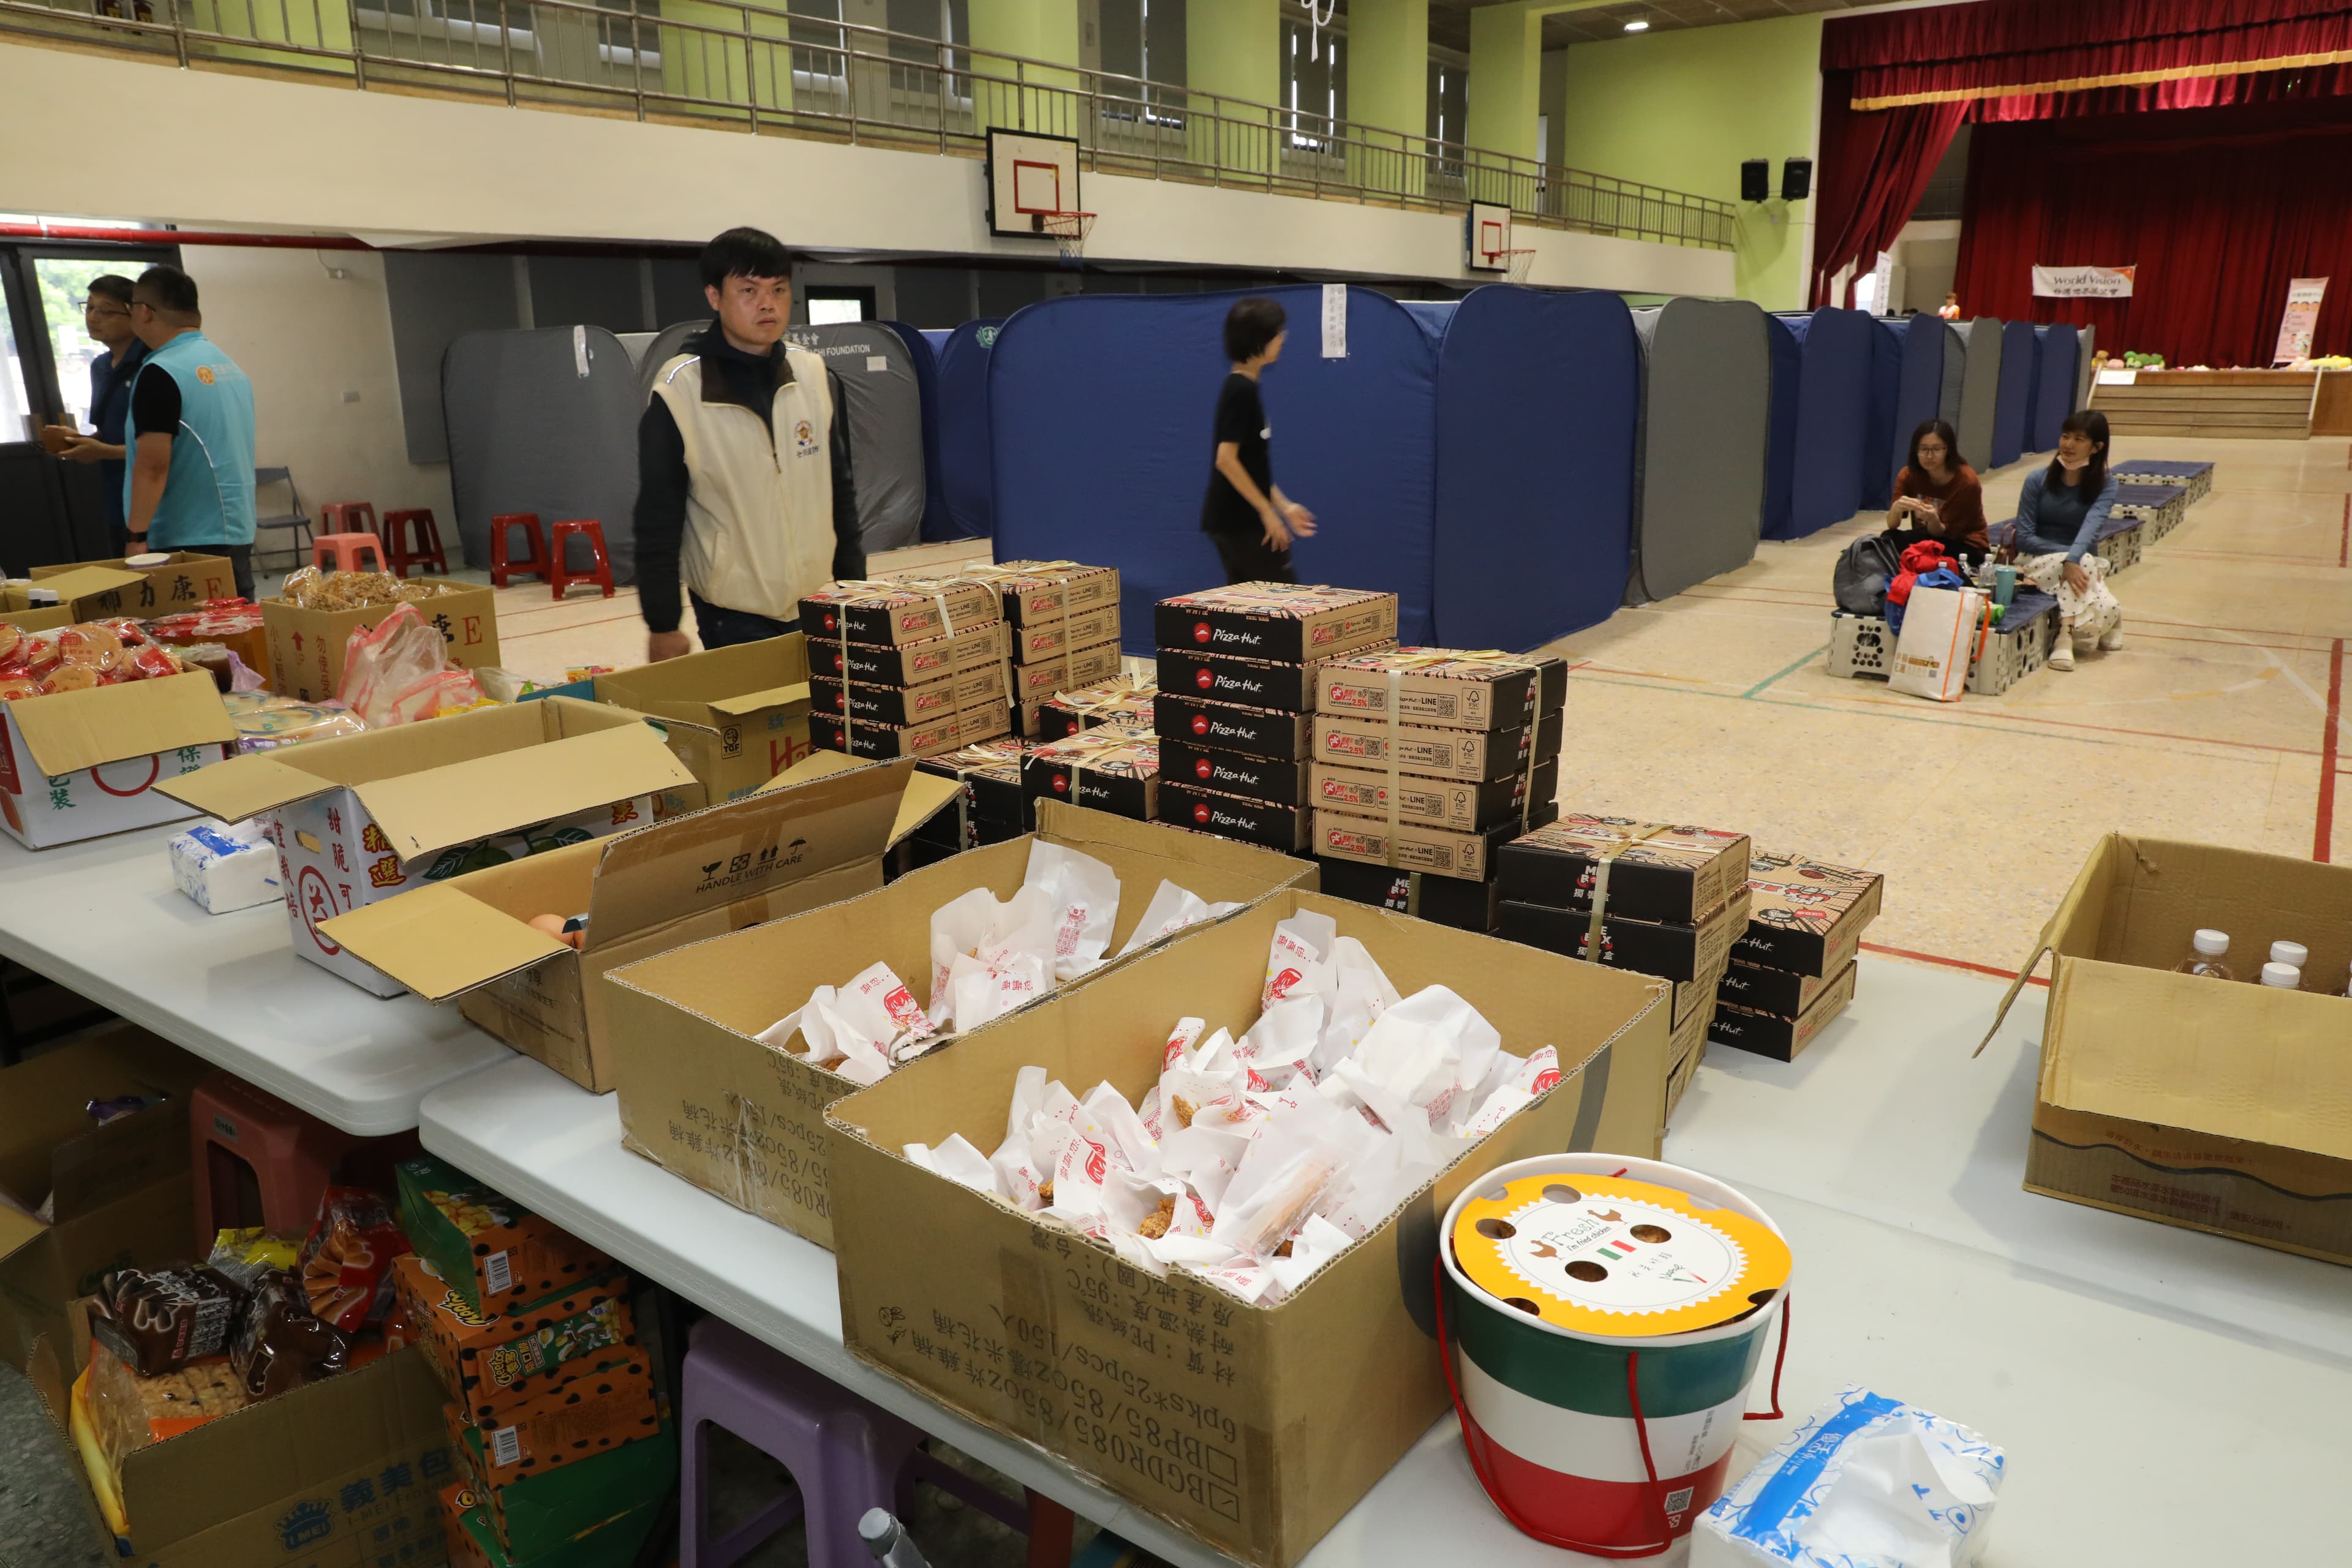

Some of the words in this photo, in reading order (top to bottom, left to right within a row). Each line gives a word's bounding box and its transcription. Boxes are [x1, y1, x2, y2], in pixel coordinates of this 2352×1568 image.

[2054, 275, 2086, 285] World
[2090, 276, 2120, 285] Vision
[827, 344, 870, 356] FOUNDATION
[462, 616, 483, 646] E
[836, 619, 853, 630] Pza
[854, 622, 866, 631] Hut
[1213, 628, 1240, 643] Pizza
[1241, 632, 1262, 644] Hut
[864, 662, 877, 672] Hut
[1215, 675, 1242, 688] Pizza
[1243, 679, 1263, 692] Hut
[865, 701, 878, 711] Hut
[1352, 698, 1367, 707] 2.5%
[1422, 697, 1437, 706] LINE
[1210, 722, 1235, 736] Pizza
[1237, 726, 1257, 740] Hut
[723, 744, 740, 753] TQF
[851, 737, 862, 747] izza
[863, 741, 876, 750] Hut
[1349, 747, 1364, 755] 2.5%
[1417, 747, 1433, 755] LINE
[1213, 766, 1238, 780] Pizza
[1240, 772, 1259, 784] Hut
[1092, 786, 1110, 799] Hut
[1344, 794, 1359, 804] 2.5%
[1410, 796, 1425, 804] LINE
[1211, 811, 1236, 825] Pizza
[1237, 817, 1257, 830] Hut
[1418, 847, 1433, 856] LINE
[696, 872, 742, 894] HANDLE
[745, 862, 774, 878] WITH
[776, 854, 804, 869] CARE
[1395, 878, 1411, 888] ME
[1584, 932, 1612, 944] BX
[1750, 938, 1774, 951] Hut
[1577, 946, 1615, 960] 獨盒
[1726, 976, 1751, 990] Hut
[1719, 1022, 1744, 1036] Hut
[1541, 1217, 1599, 1246] Fresh
[1566, 1242, 1578, 1251] I'm
[1577, 1233, 1593, 1248] fried
[1591, 1225, 1611, 1239] chicken
[494, 1349, 513, 1385] Cheetos
